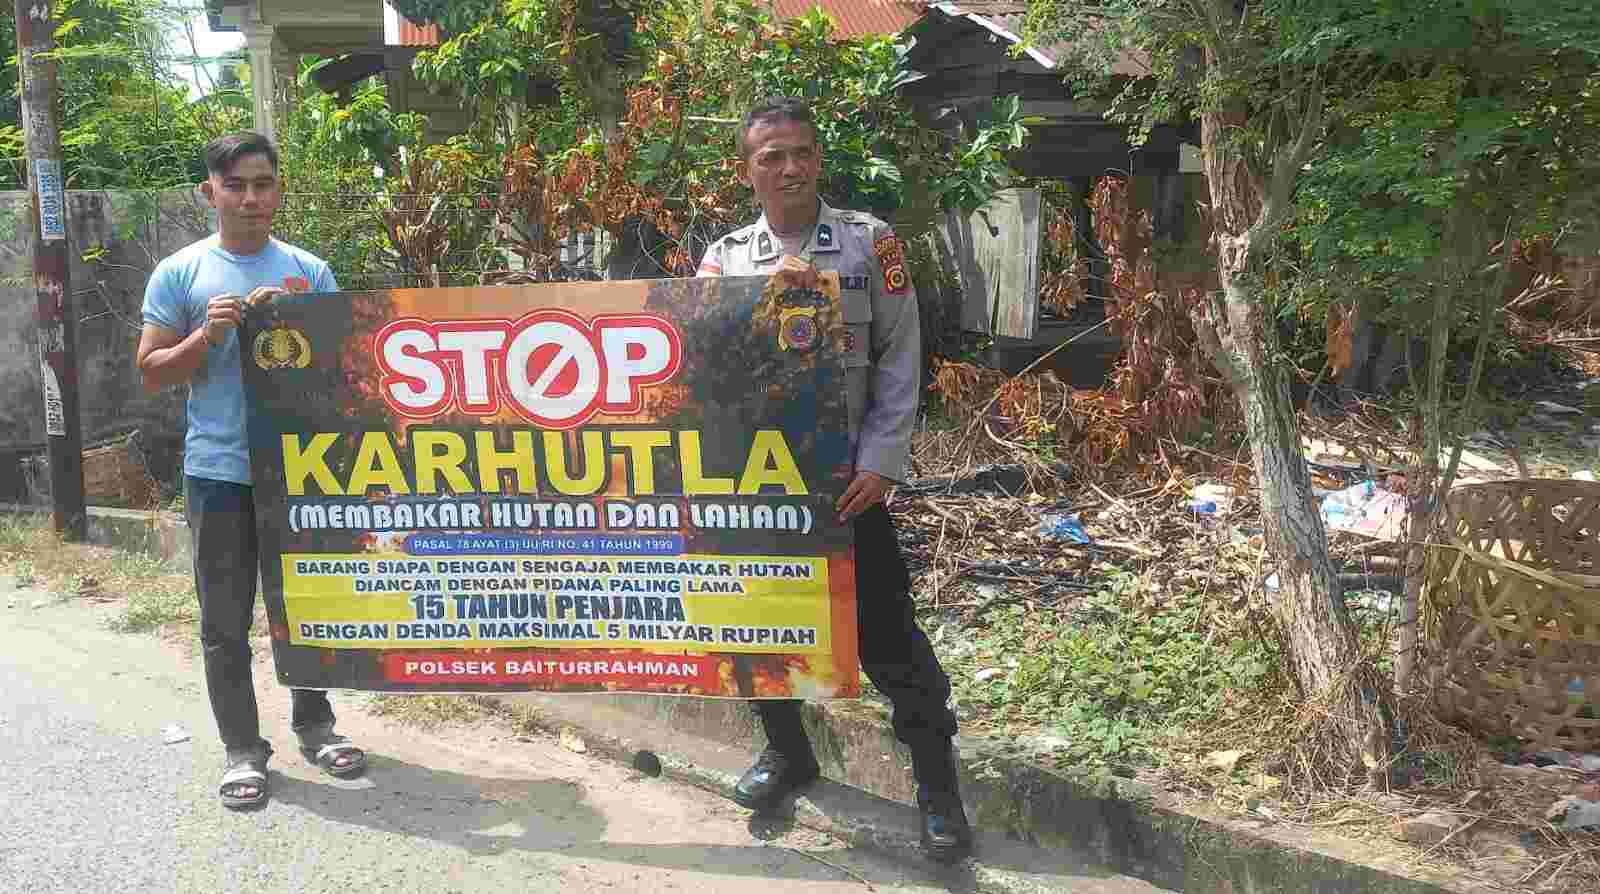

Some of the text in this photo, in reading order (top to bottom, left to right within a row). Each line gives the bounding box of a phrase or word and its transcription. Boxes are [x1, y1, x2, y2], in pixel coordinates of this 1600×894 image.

[384, 320, 671, 420] STOP
[281, 430, 809, 496] KARHUTLA
[288, 503, 813, 535] (MEMBAKAR HUTAN DAN LAHAN)
[414, 538, 452, 550] PASAL
[472, 538, 501, 550] AYAT
[521, 538, 539, 550] UU
[542, 538, 554, 550] RI
[555, 538, 579, 550] NO.
[581, 538, 595, 550] 41
[600, 538, 641, 550] TAHUN
[646, 538, 673, 550] 1999
[296, 560, 810, 578] BARANG SIAPA DENGAN SENGAJA MEMBAKAR HUTAN
[354, 577, 744, 594] DIANCAM DENGAN PIDANA PALING LAMA
[408, 593, 686, 622] 15 TAHUN PENJARA
[300, 622, 816, 645] DENGAN DENDA MAKSIMAL 5 MILYAR RUPIAH
[404, 659, 698, 677] POLSEK BAITURRAHMAN
